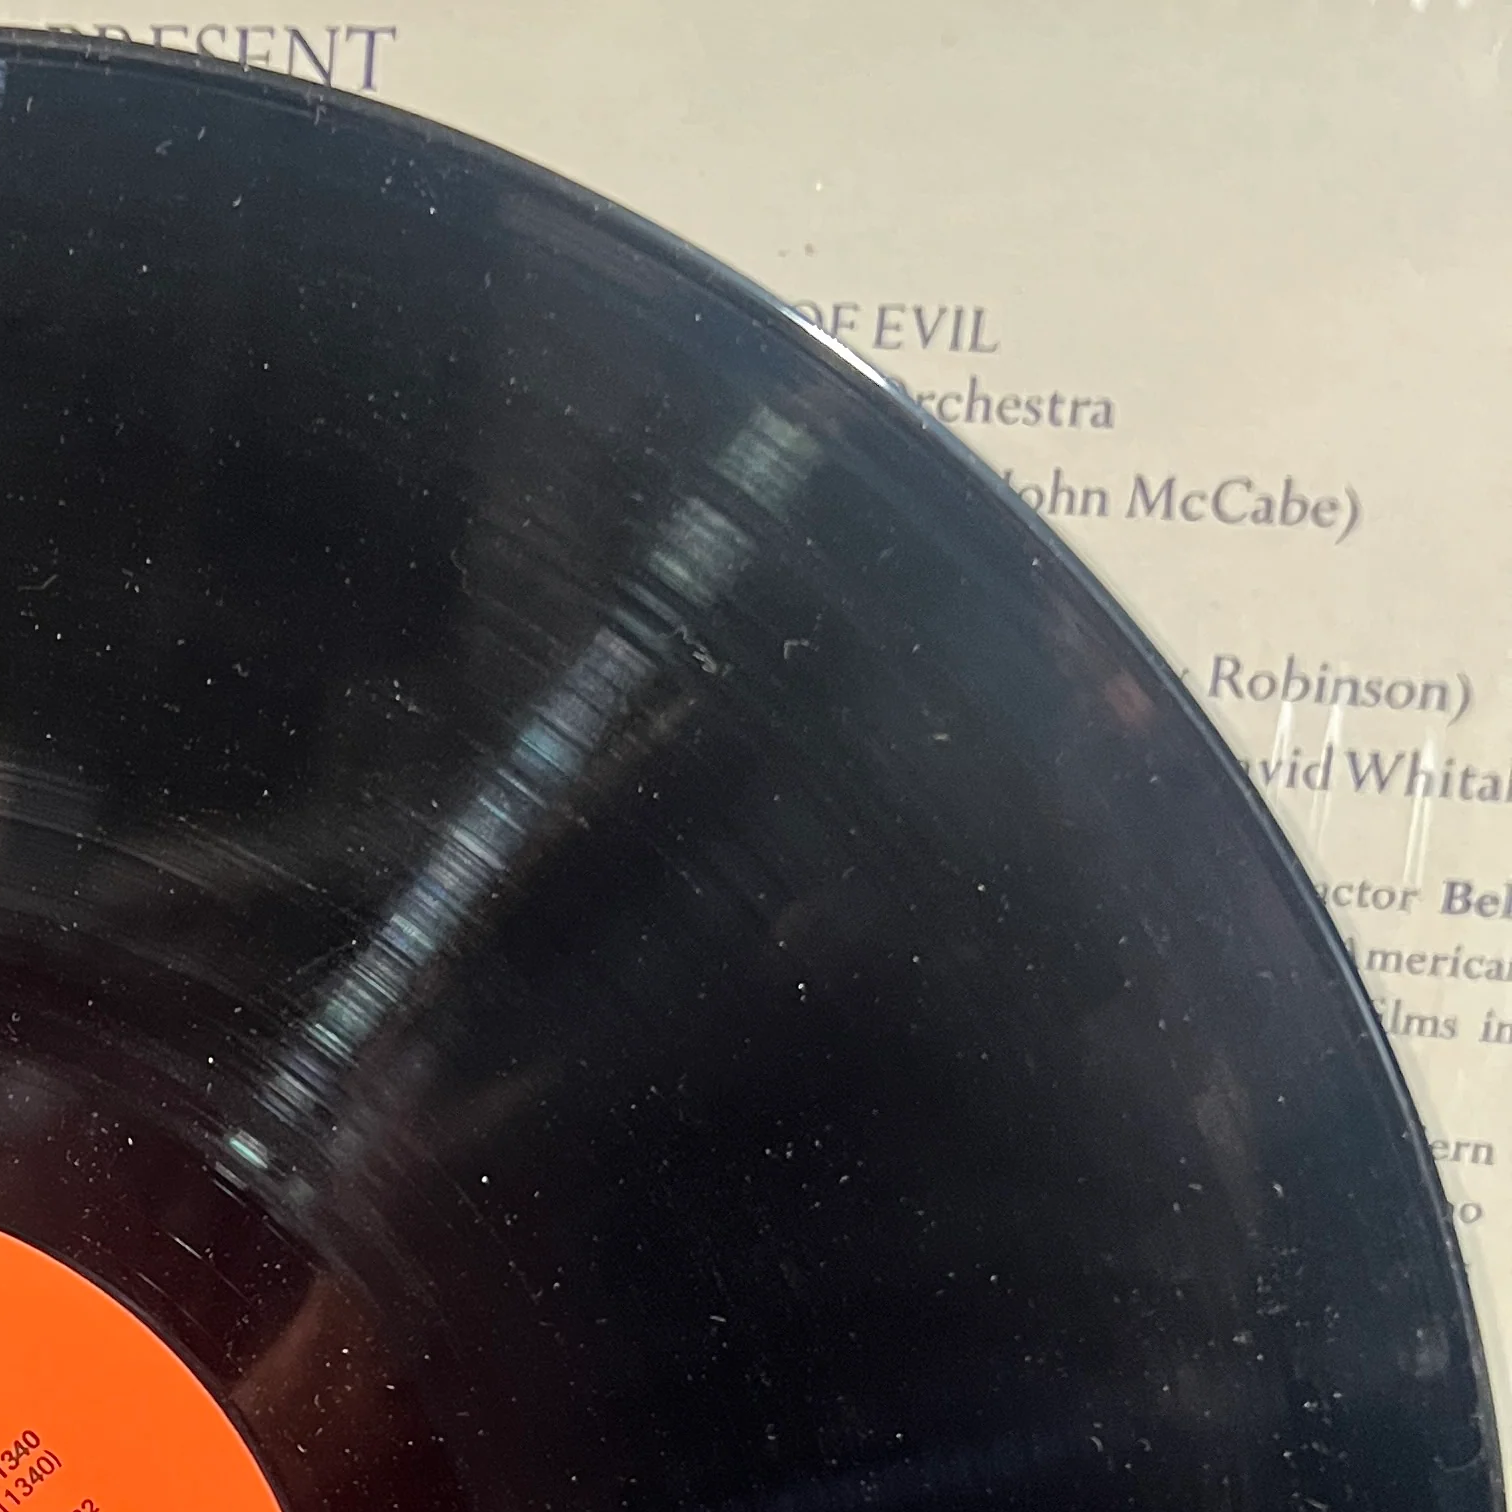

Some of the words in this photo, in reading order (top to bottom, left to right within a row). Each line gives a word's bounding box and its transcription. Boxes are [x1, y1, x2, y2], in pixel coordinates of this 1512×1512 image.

[872, 304, 1001, 354] EVIL
[1124, 473, 1363, 545] McCabe)
[1208, 653, 1474, 727] Robinson)
